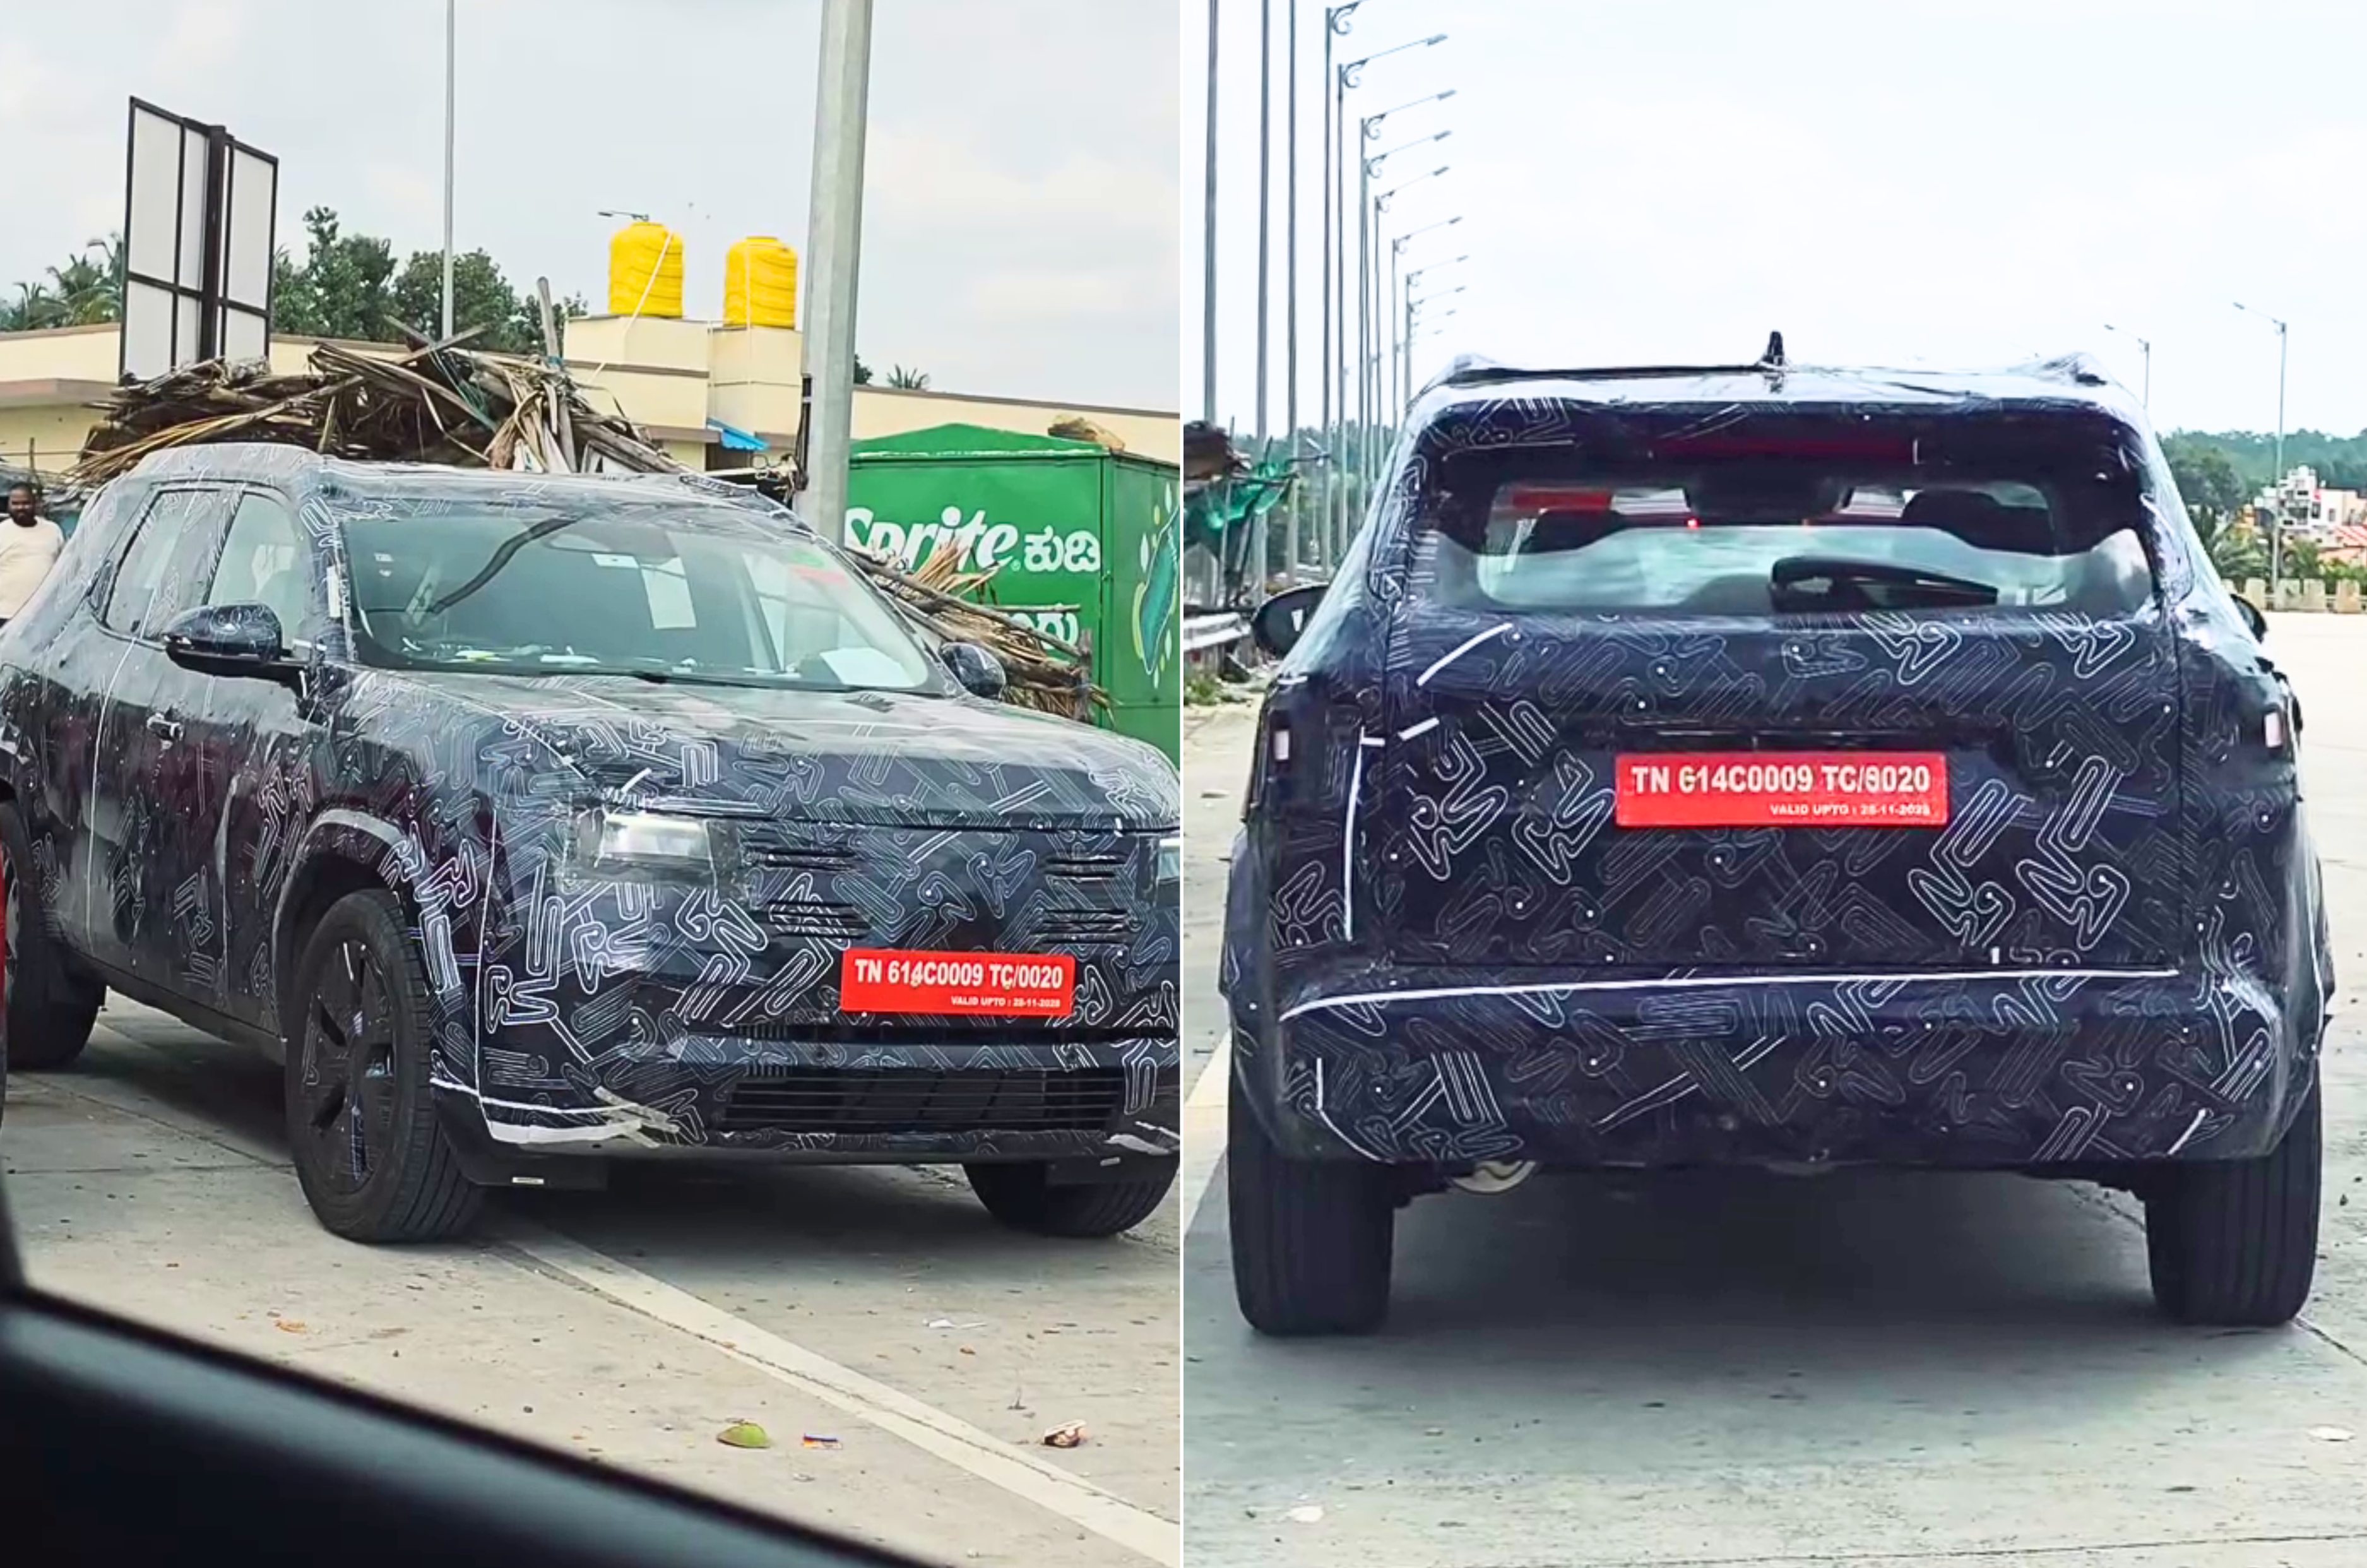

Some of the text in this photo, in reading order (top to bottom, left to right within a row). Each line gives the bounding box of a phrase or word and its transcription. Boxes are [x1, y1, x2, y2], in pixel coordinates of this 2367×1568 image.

[843, 506, 1019, 573] Sprite
[1632, 766, 1670, 793] TN
[1679, 765, 1813, 793] 614C0009
[1770, 804, 1808, 816] VALID
[1813, 804, 1849, 816] UPTO
[854, 959, 1063, 989] TN 614C0009 TC/0020
[951, 995, 979, 1006] VALID
[980, 997, 1006, 1007] UPTO
